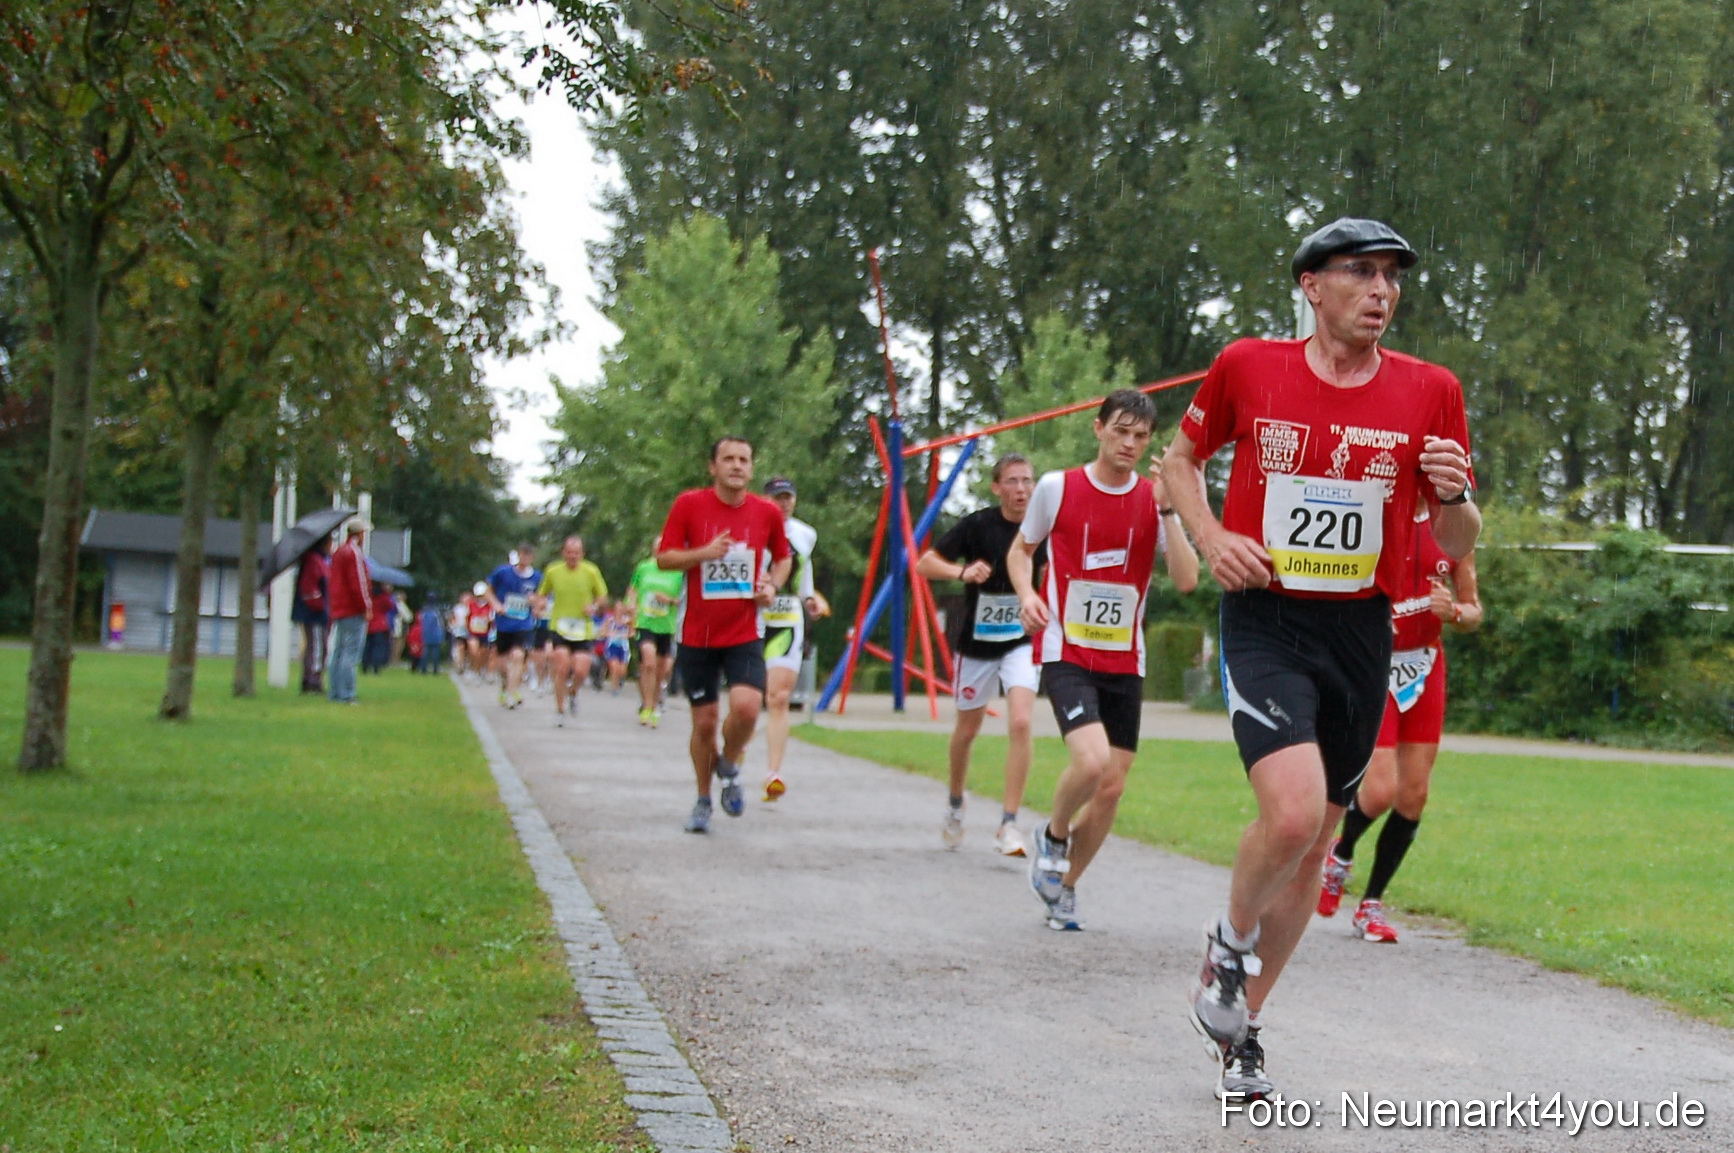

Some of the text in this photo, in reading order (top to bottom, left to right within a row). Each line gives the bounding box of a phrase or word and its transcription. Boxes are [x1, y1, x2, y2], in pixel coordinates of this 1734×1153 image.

[1260, 427, 1299, 441] IMMER
[1330, 424, 1409, 444] 11. NEUMARKTER
[1259, 436, 1299, 451] WIEDER
[1262, 446, 1296, 463] NEU
[1262, 459, 1294, 472] MARKT
[1288, 507, 1363, 551] 220
[1284, 556, 1359, 577] Johannes
[1083, 600, 1122, 625] 125
